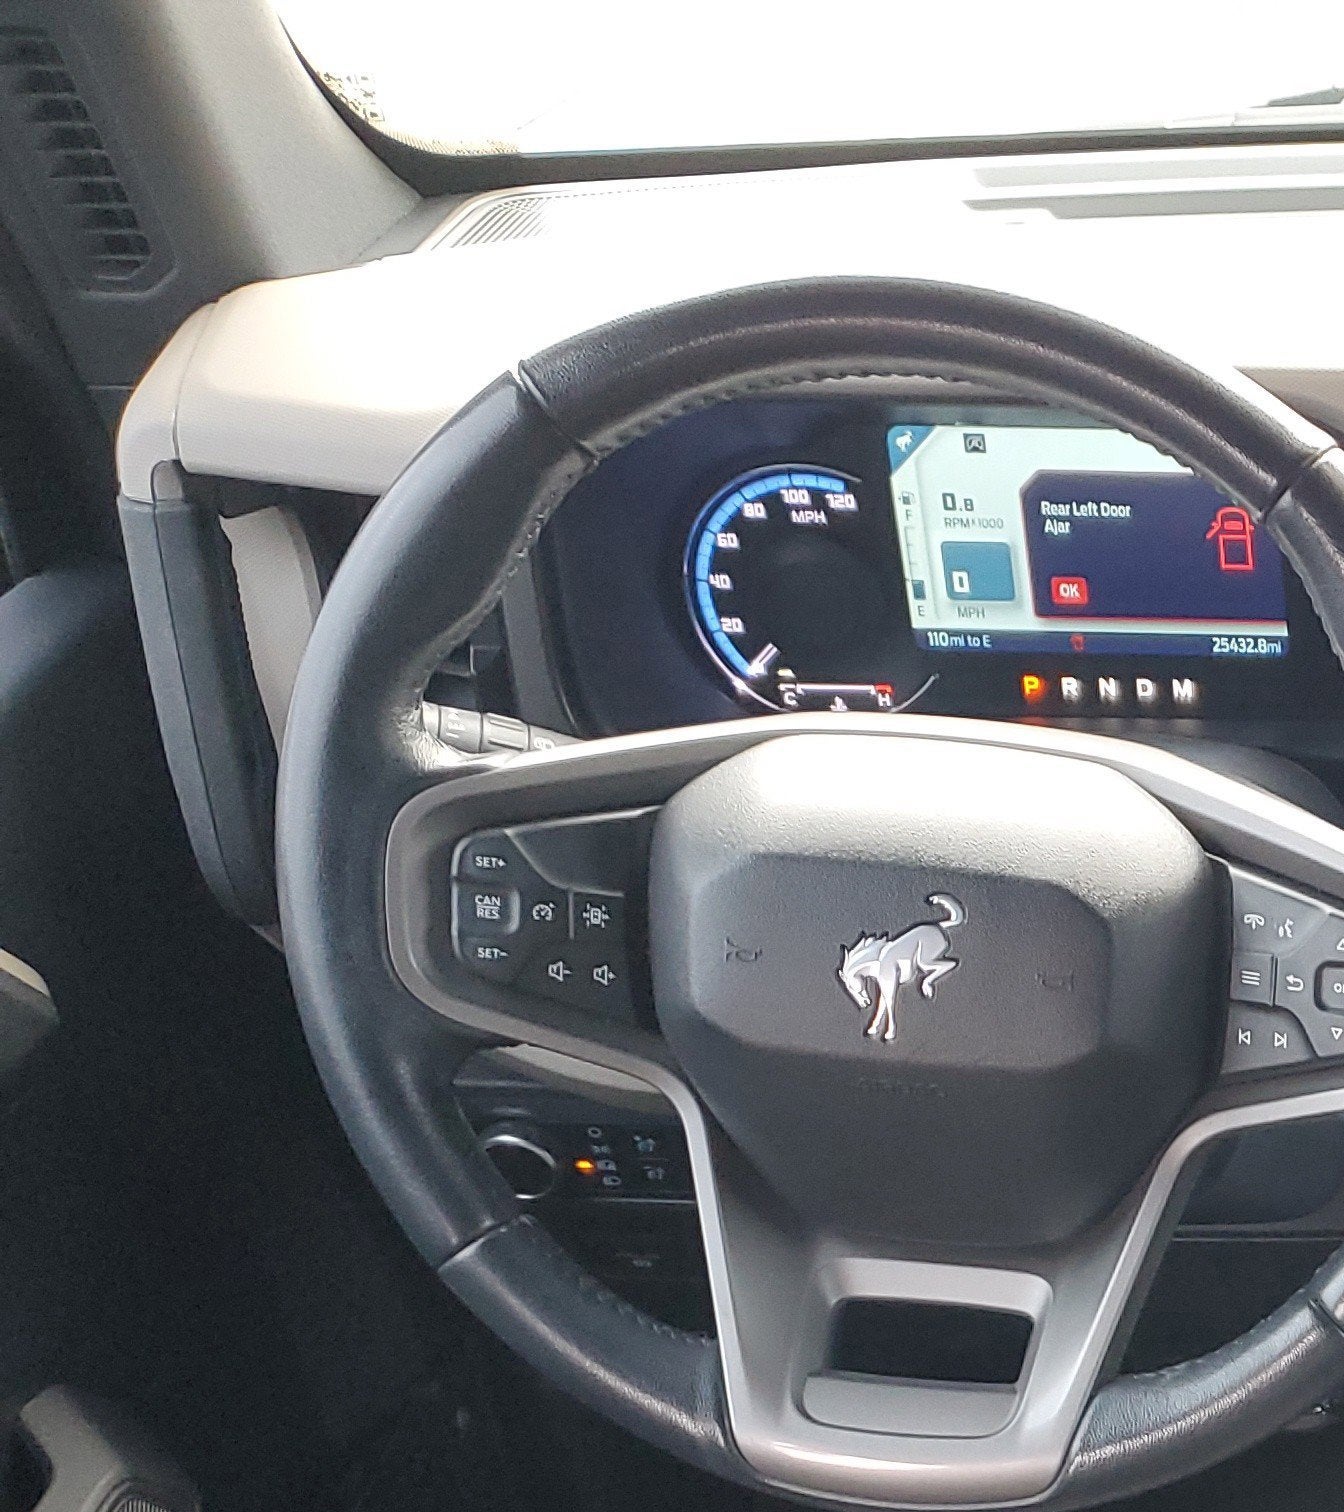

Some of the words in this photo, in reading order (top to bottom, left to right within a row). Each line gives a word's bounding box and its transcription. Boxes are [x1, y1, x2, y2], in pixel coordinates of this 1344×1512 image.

[780, 489, 811, 505] 100
[825, 493, 858, 511] 120
[941, 492, 974, 512] 0.8
[743, 502, 767, 519] 80
[1041, 501, 1070, 517] Rear
[1072, 501, 1098, 517] Left
[1100, 501, 1131, 517] Door
[791, 510, 828, 525] MPH
[1044, 518, 1070, 535] Ajar
[716, 532, 739, 549] 60
[709, 573, 733, 590] 40
[1059, 583, 1080, 598] OK
[918, 606, 925, 617] E
[957, 606, 986, 619] MPH
[720, 617, 746, 634] 20
[967, 635, 980, 647] to
[983, 634, 993, 648] E
[1023, 675, 1040, 697] P
[1061, 676, 1079, 697] R
[1098, 677, 1116, 697] N
[1136, 678, 1154, 697] D
[1172, 678, 1194, 699] M
[878, 692, 891, 707] H
[475, 895, 500, 906] CAN
[477, 908, 500, 919] RES
